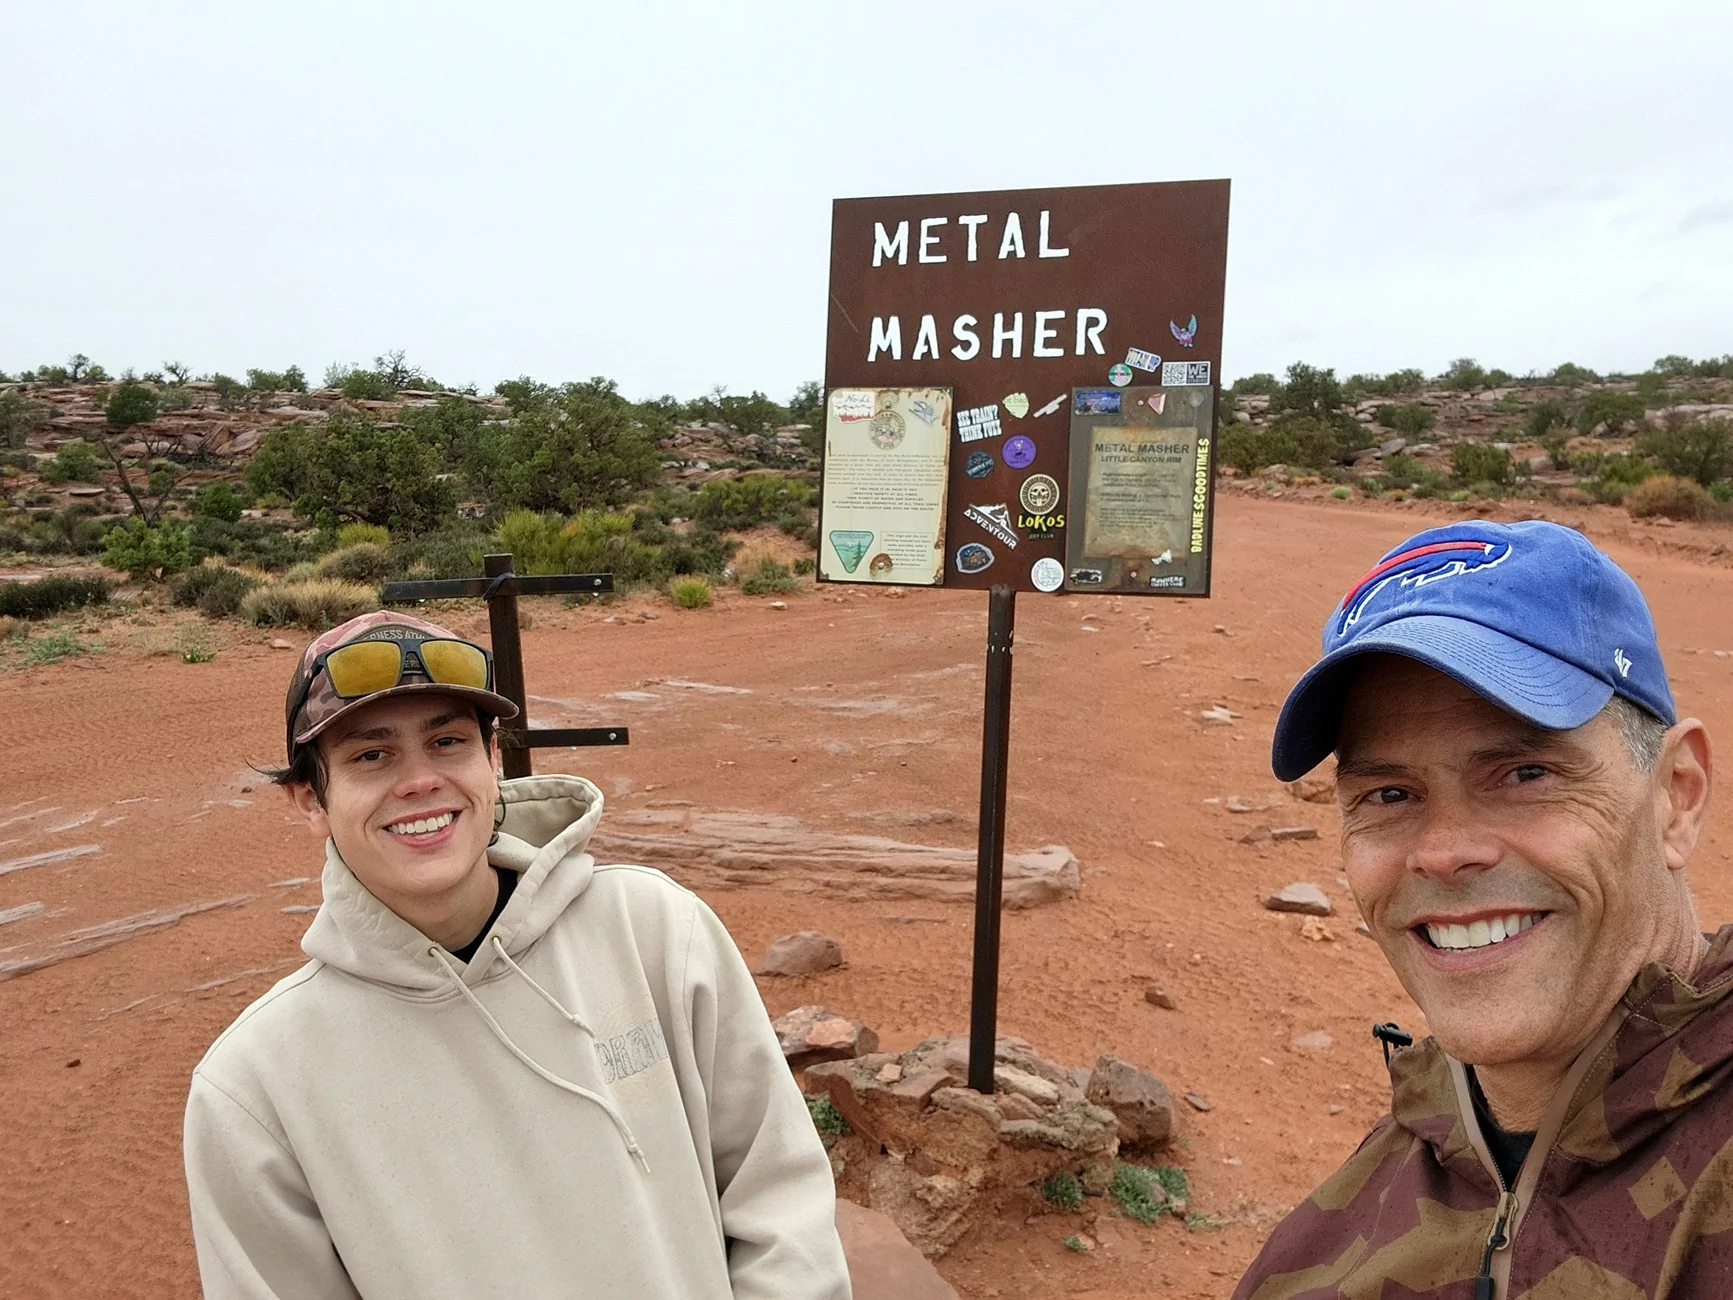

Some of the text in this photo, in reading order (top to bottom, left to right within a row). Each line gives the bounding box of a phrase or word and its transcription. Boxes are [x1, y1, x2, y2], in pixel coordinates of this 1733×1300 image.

[872, 210, 1069, 267] METAL
[867, 308, 1108, 362] MASHER
[1188, 364, 1207, 375] WE
[1095, 443, 1190, 454] METAL MASHER
[1101, 455, 1129, 463] LITTLE
[964, 509, 1018, 549] ADVENTOUR
